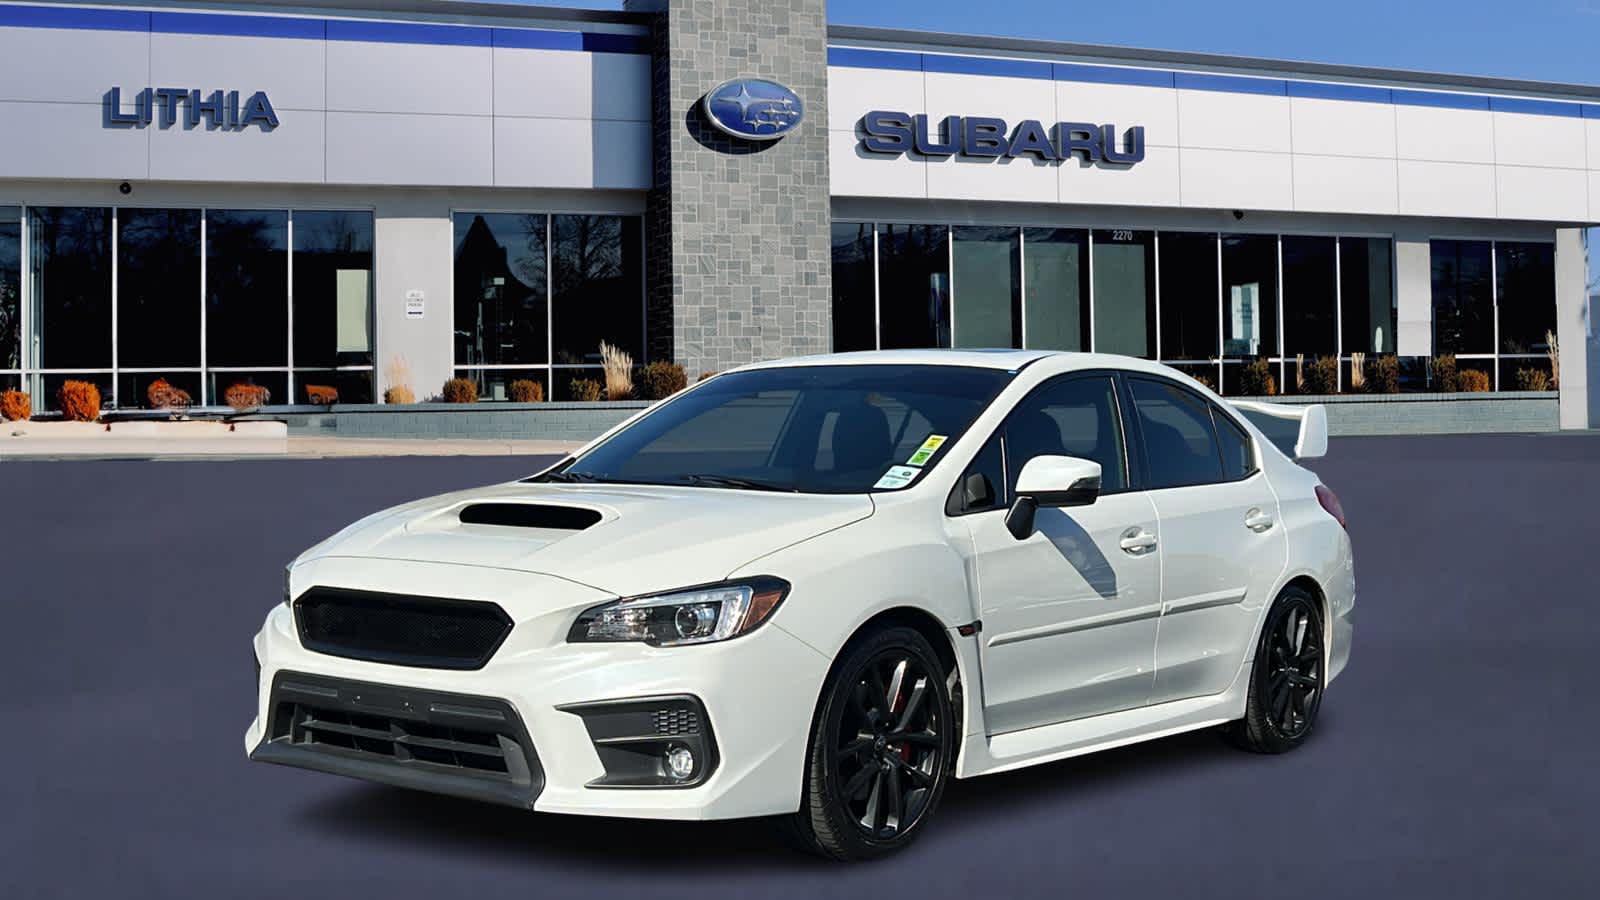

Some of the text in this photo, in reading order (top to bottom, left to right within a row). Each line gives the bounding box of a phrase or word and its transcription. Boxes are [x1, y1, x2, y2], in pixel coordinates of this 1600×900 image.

[107, 86, 280, 130] LITHIA
[860, 110, 1145, 166] SUBARU
[1112, 230, 1133, 241] 2270
